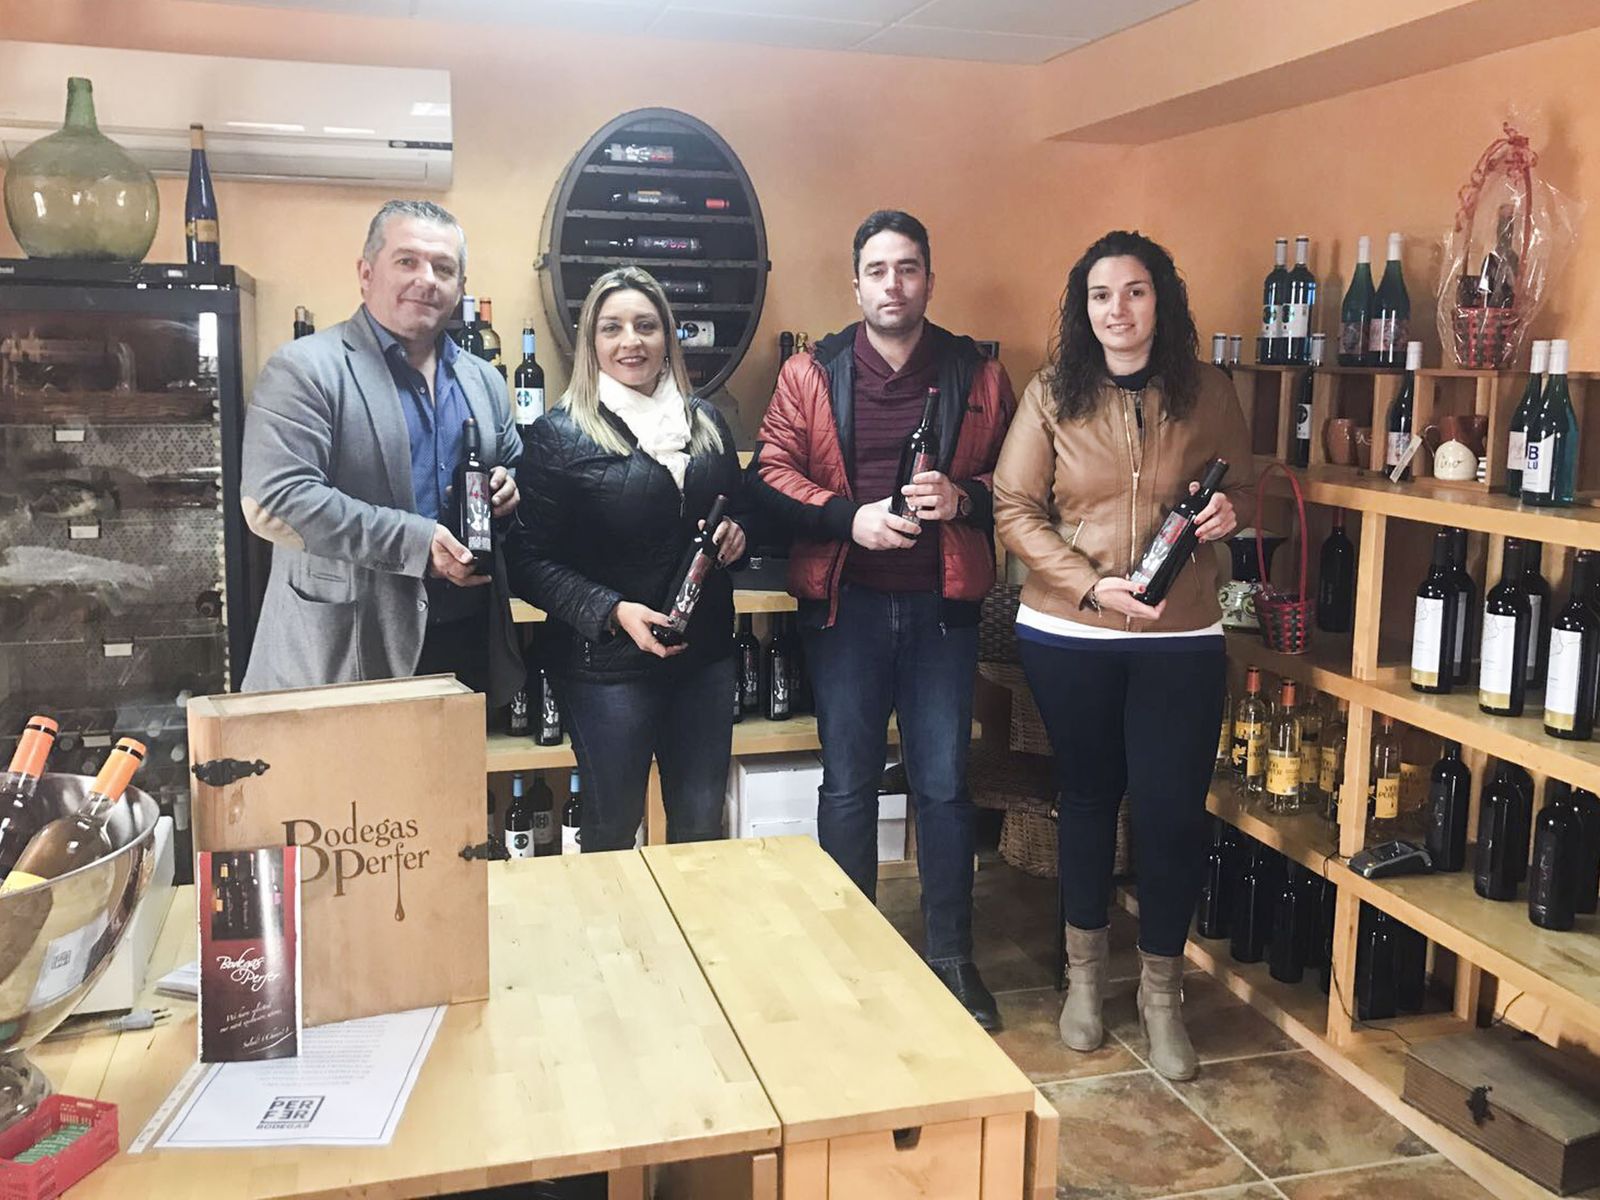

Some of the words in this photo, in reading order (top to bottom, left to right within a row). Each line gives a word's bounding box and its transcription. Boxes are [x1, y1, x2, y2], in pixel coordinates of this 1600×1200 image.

[1527, 445, 1539, 461] B
[281, 800, 419, 884] Bodegas
[332, 841, 430, 922] Perfer
[216, 947, 265, 972] Bodegas
[230, 968, 281, 992] Perfer
[268, 1099, 315, 1110] PER
[256, 1122, 311, 1130] BODEGAS
